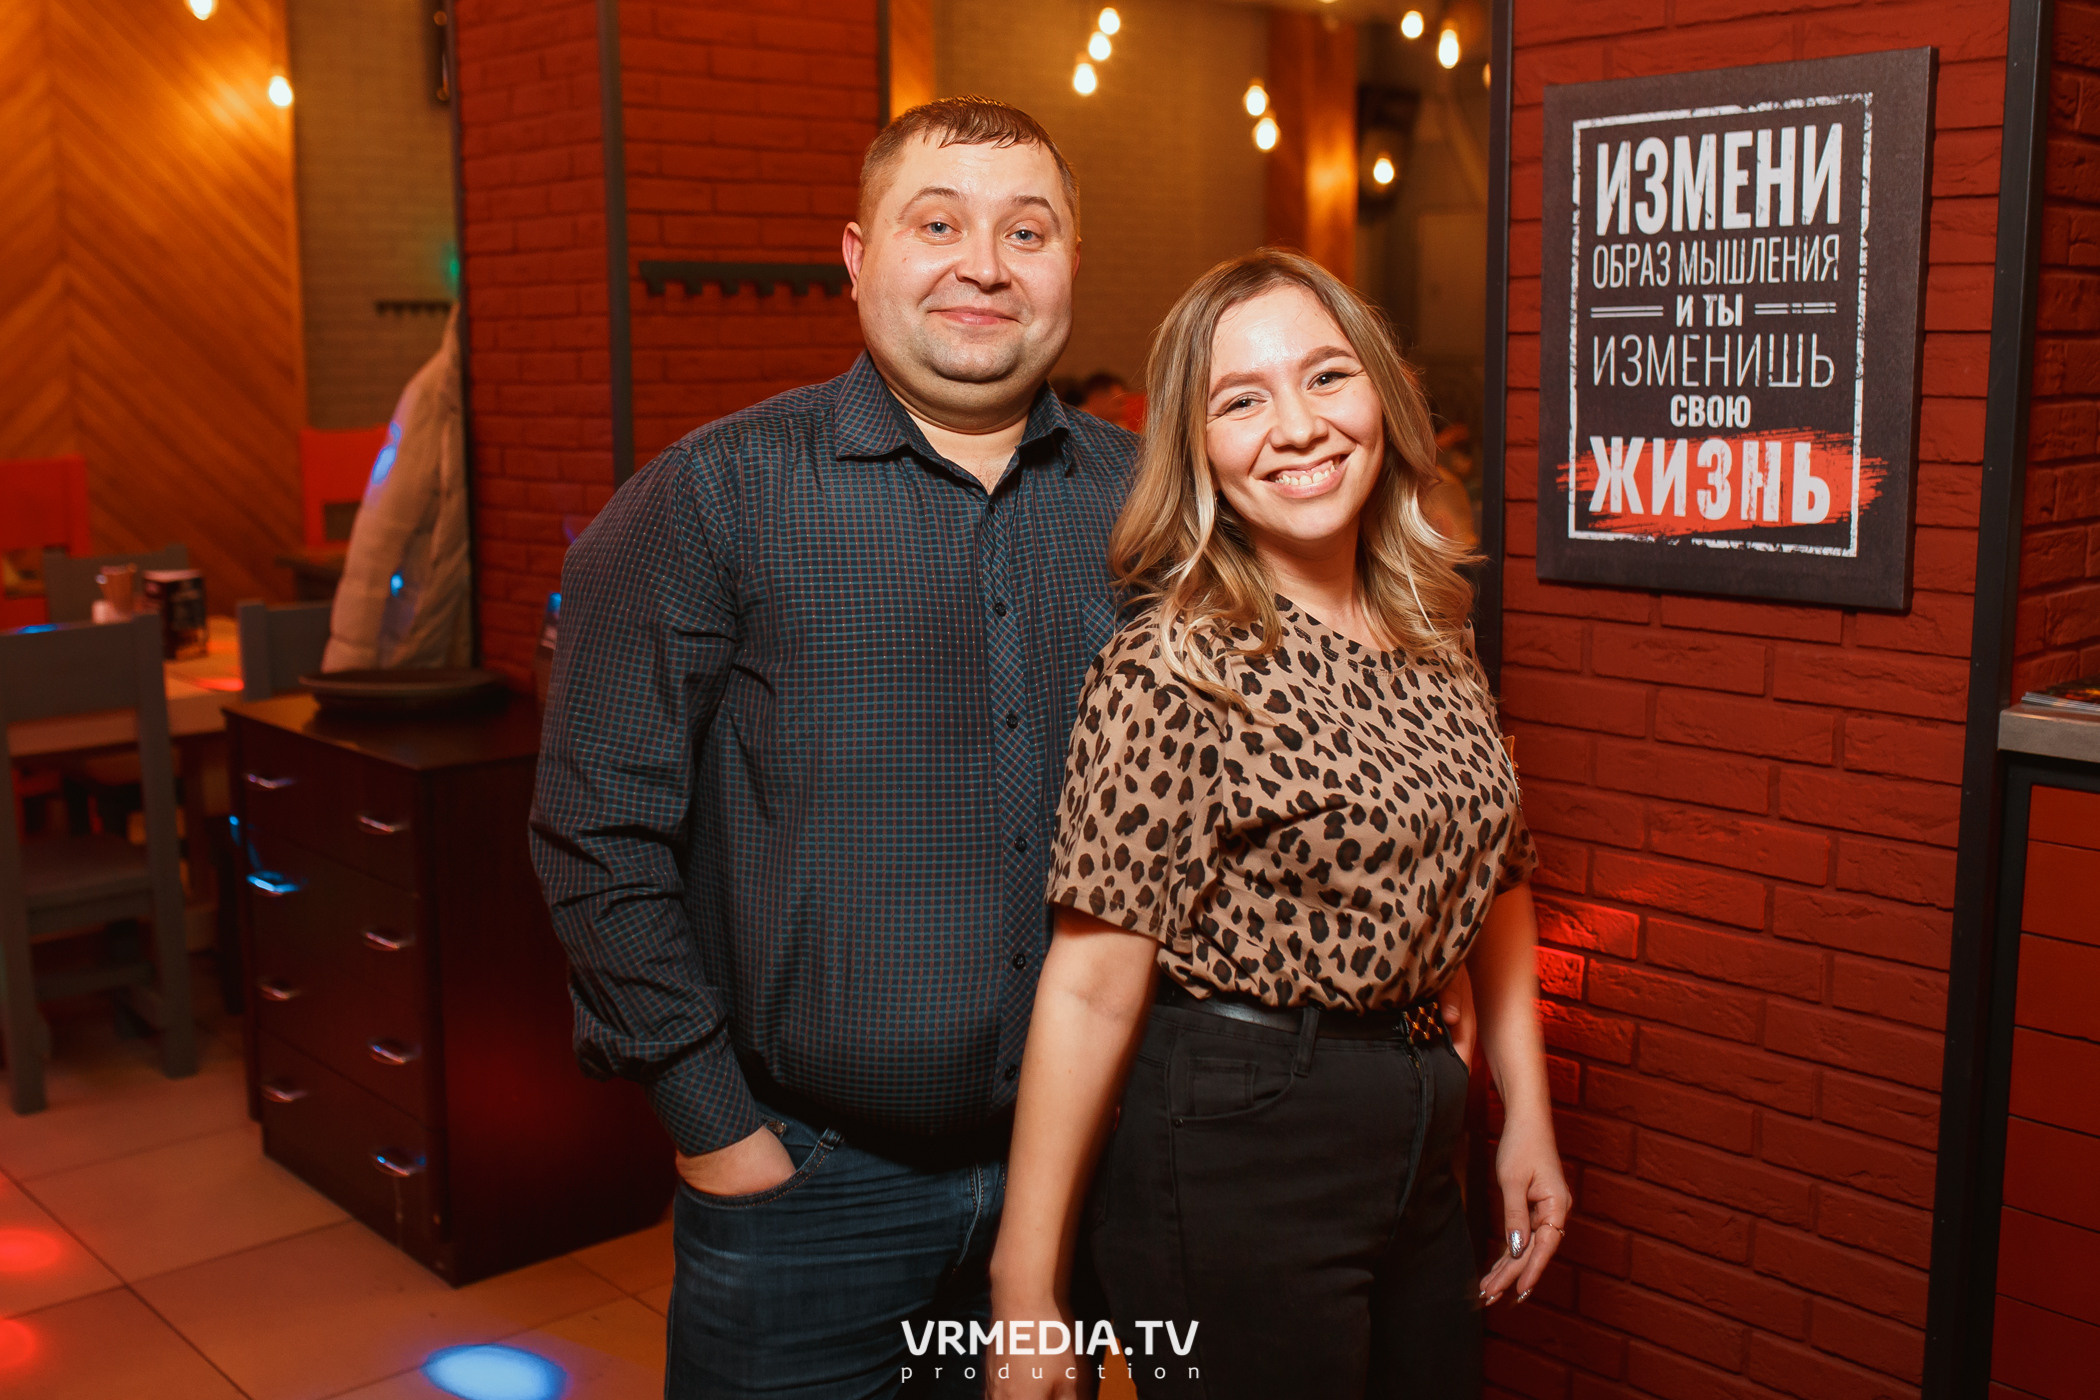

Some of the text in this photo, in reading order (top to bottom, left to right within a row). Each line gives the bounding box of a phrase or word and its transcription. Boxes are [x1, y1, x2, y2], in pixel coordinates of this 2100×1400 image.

[1596, 123, 1843, 236] ИЗМЕНИ
[1593, 234, 1840, 289] ОБРАЗ МЫШЛЕНИЯ
[1676, 293, 1743, 327] И ТЫ
[1593, 333, 1835, 387] ИЗМЕНИШЬ
[1670, 394, 1751, 428] СВОЮ
[1588, 435, 1831, 524] ЖИЗНЬ
